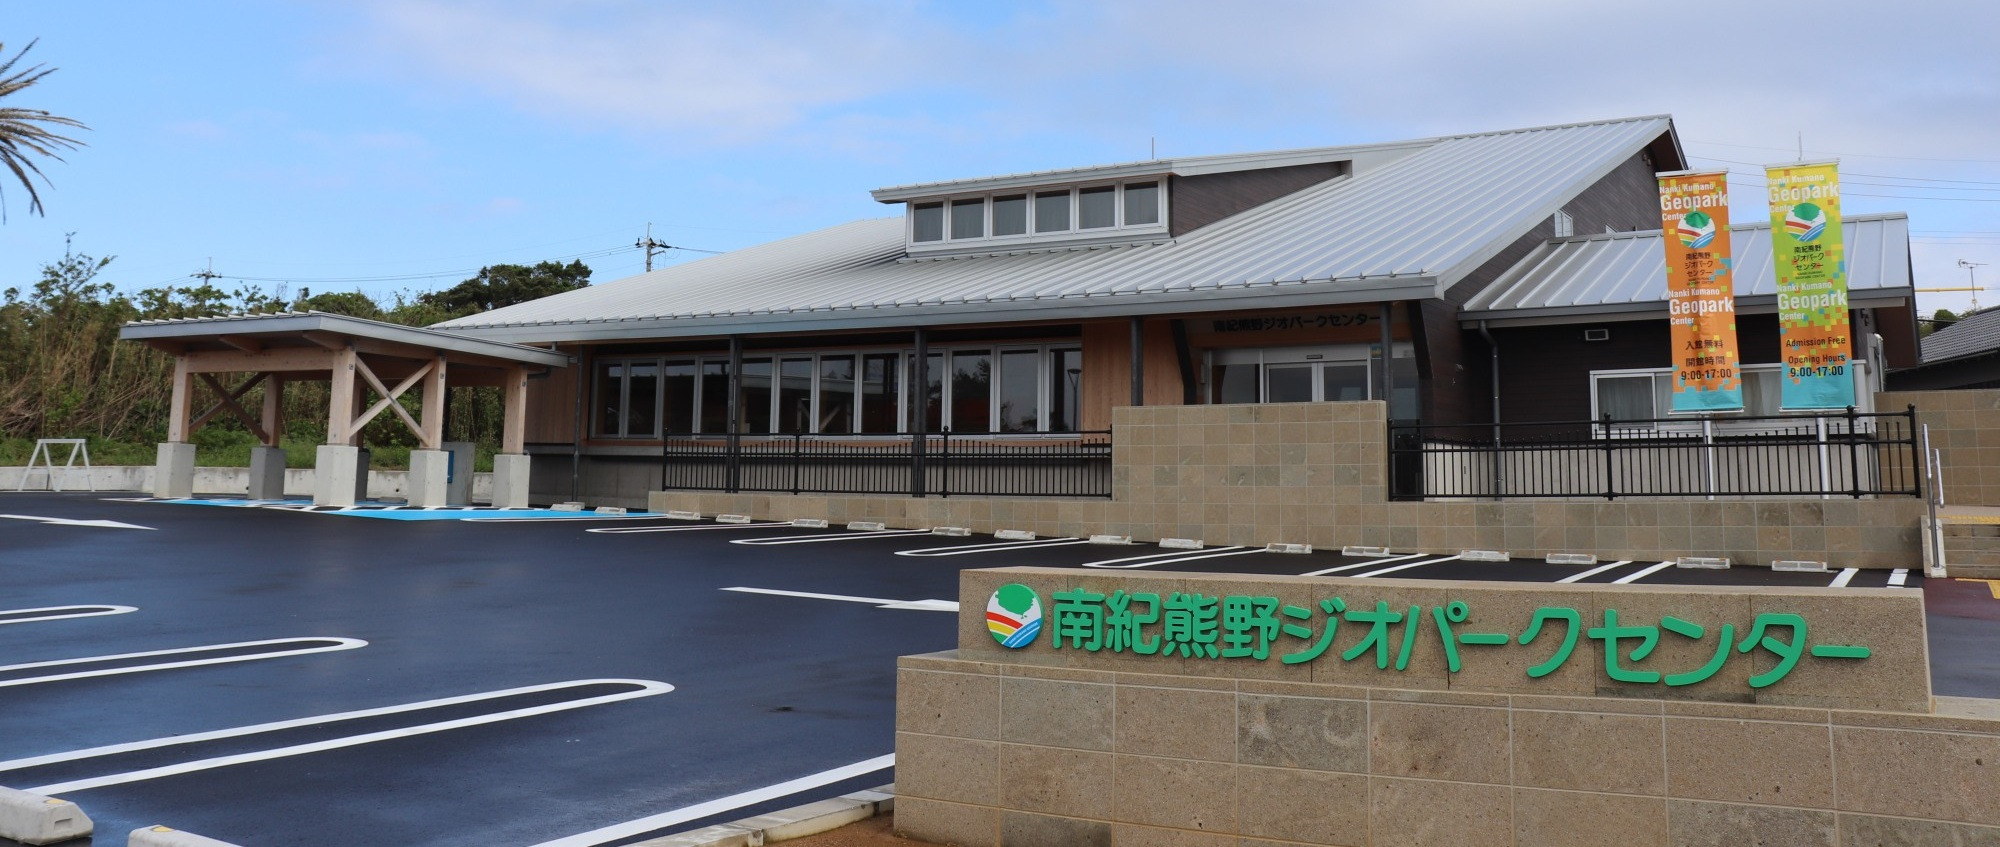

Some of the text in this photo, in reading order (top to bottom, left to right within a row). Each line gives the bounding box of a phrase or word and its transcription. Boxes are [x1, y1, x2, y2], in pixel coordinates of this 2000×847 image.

[1767, 174, 1825, 186] Nanki Kumano
[1659, 182, 1715, 194] Nanki Kumano
[1768, 181, 1839, 204] Geopark
[1660, 190, 1728, 211] Geopark
[1795, 262, 1823, 271] センター
[1776, 281, 1833, 292] Nanki Kumano
[1668, 288, 1720, 298] Nanki Kumano
[1669, 296, 1734, 316] Geopark
[1777, 289, 1848, 311] Geopark
[1670, 317, 1695, 325] Center
[1779, 311, 1805, 321] Center
[1685, 339, 1724, 350] 入館無料
[1786, 336, 1846, 347] Admission Free
[1686, 355, 1725, 367] 開館時間
[1788, 353, 1846, 365] Opening Hours
[1681, 368, 1732, 381] 9:00-17:00
[1790, 365, 1844, 377] 9:00-17:00
[1051, 587, 1871, 688] 南紀熊野ジオパークセンター
